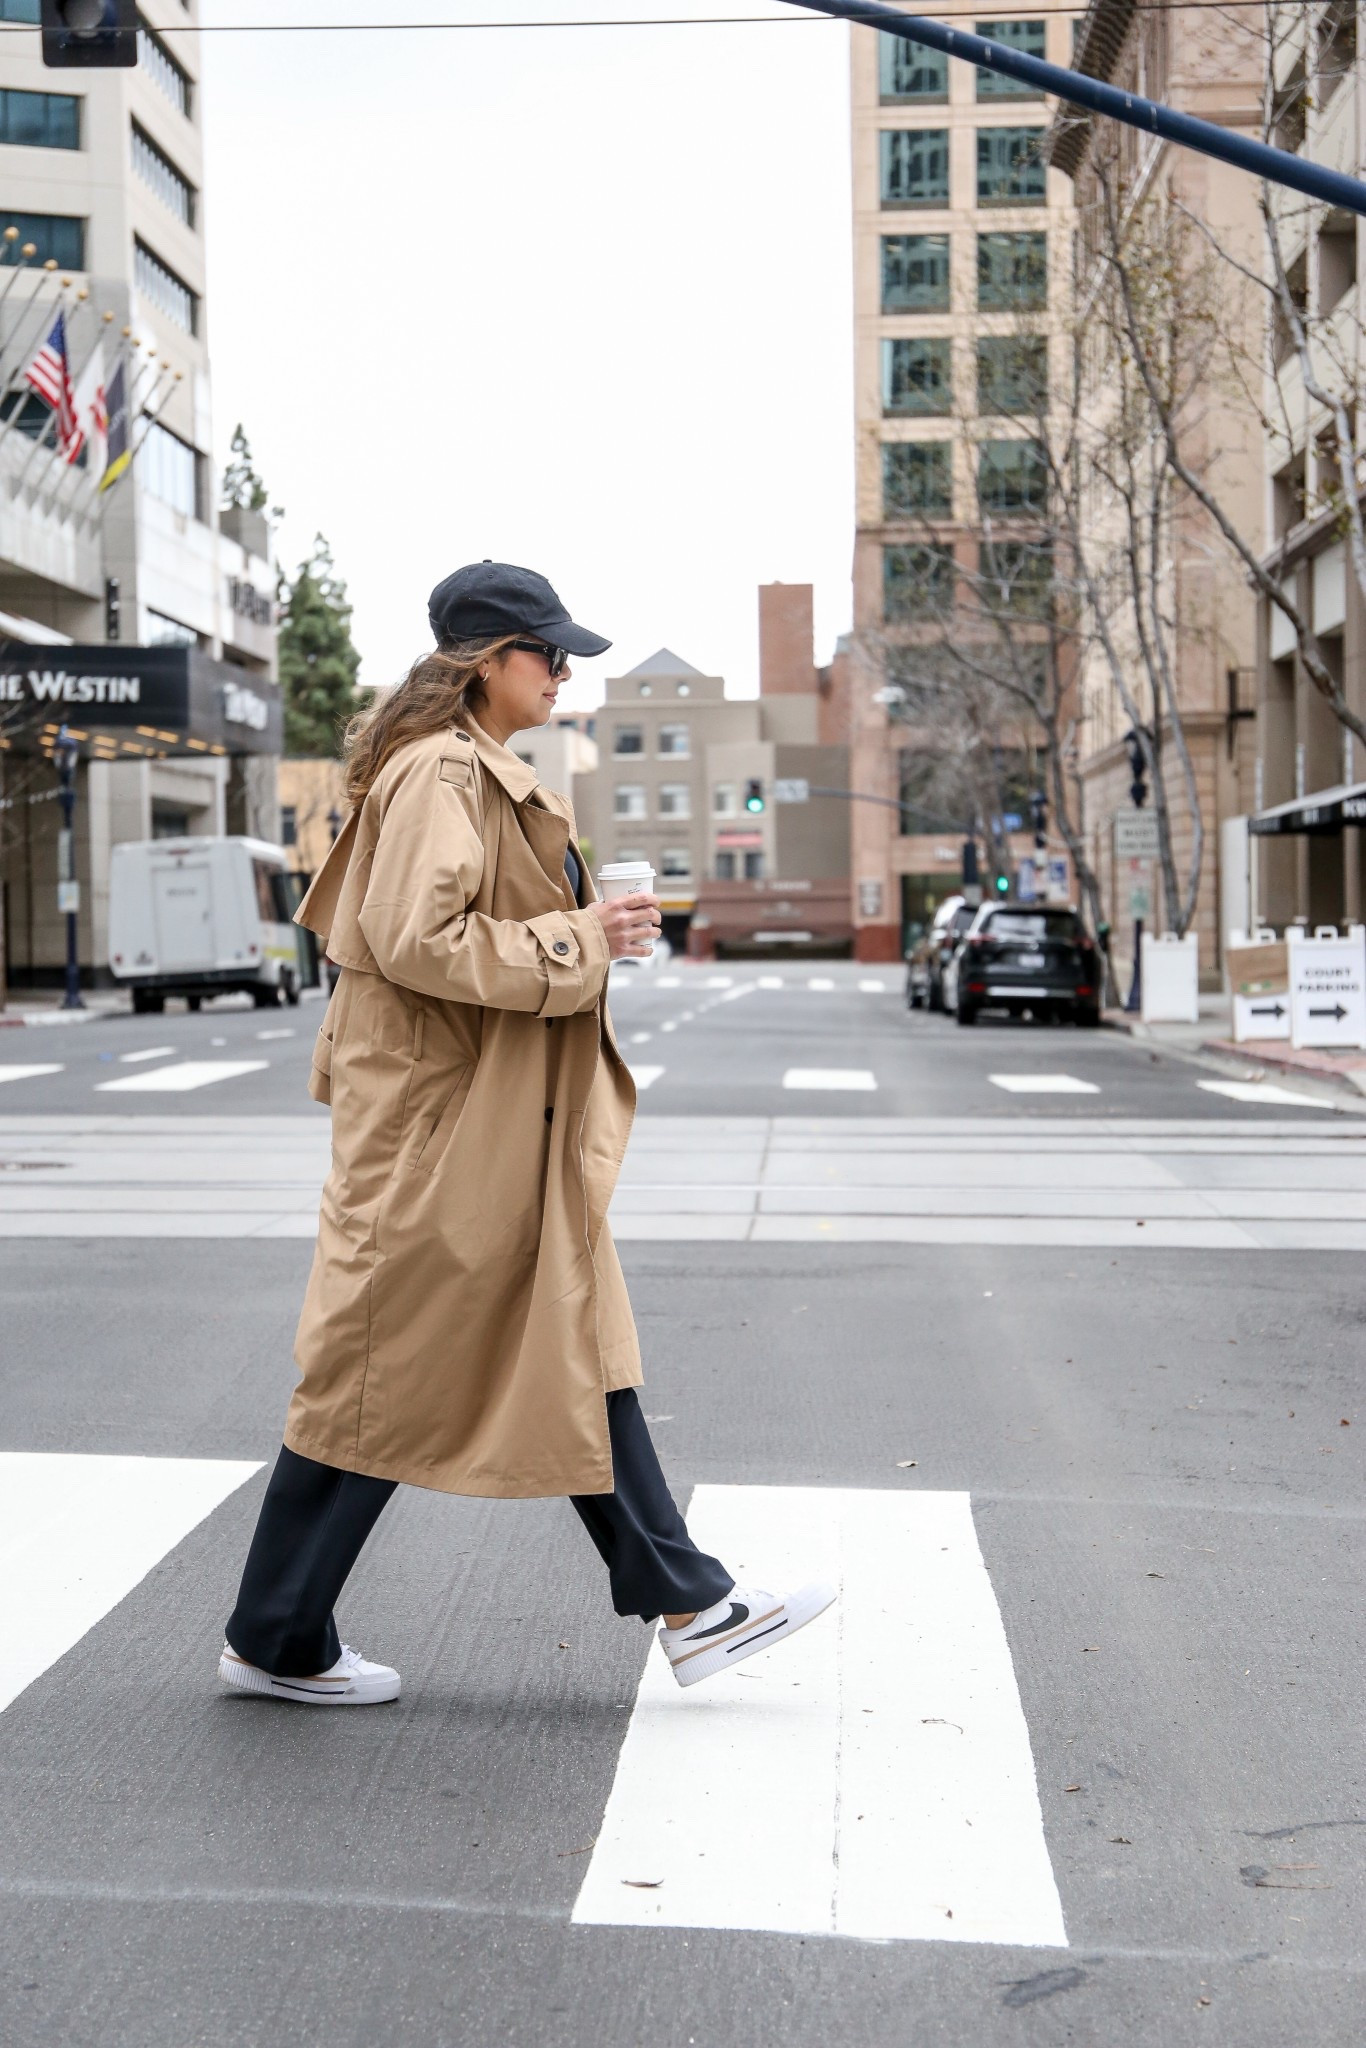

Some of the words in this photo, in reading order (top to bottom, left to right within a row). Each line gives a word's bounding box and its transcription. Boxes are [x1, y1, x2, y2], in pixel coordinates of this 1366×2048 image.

[28, 670, 140, 702] WESTIN
[1305, 967, 1352, 978] COURT
[1298, 982, 1360, 993] PARKING
